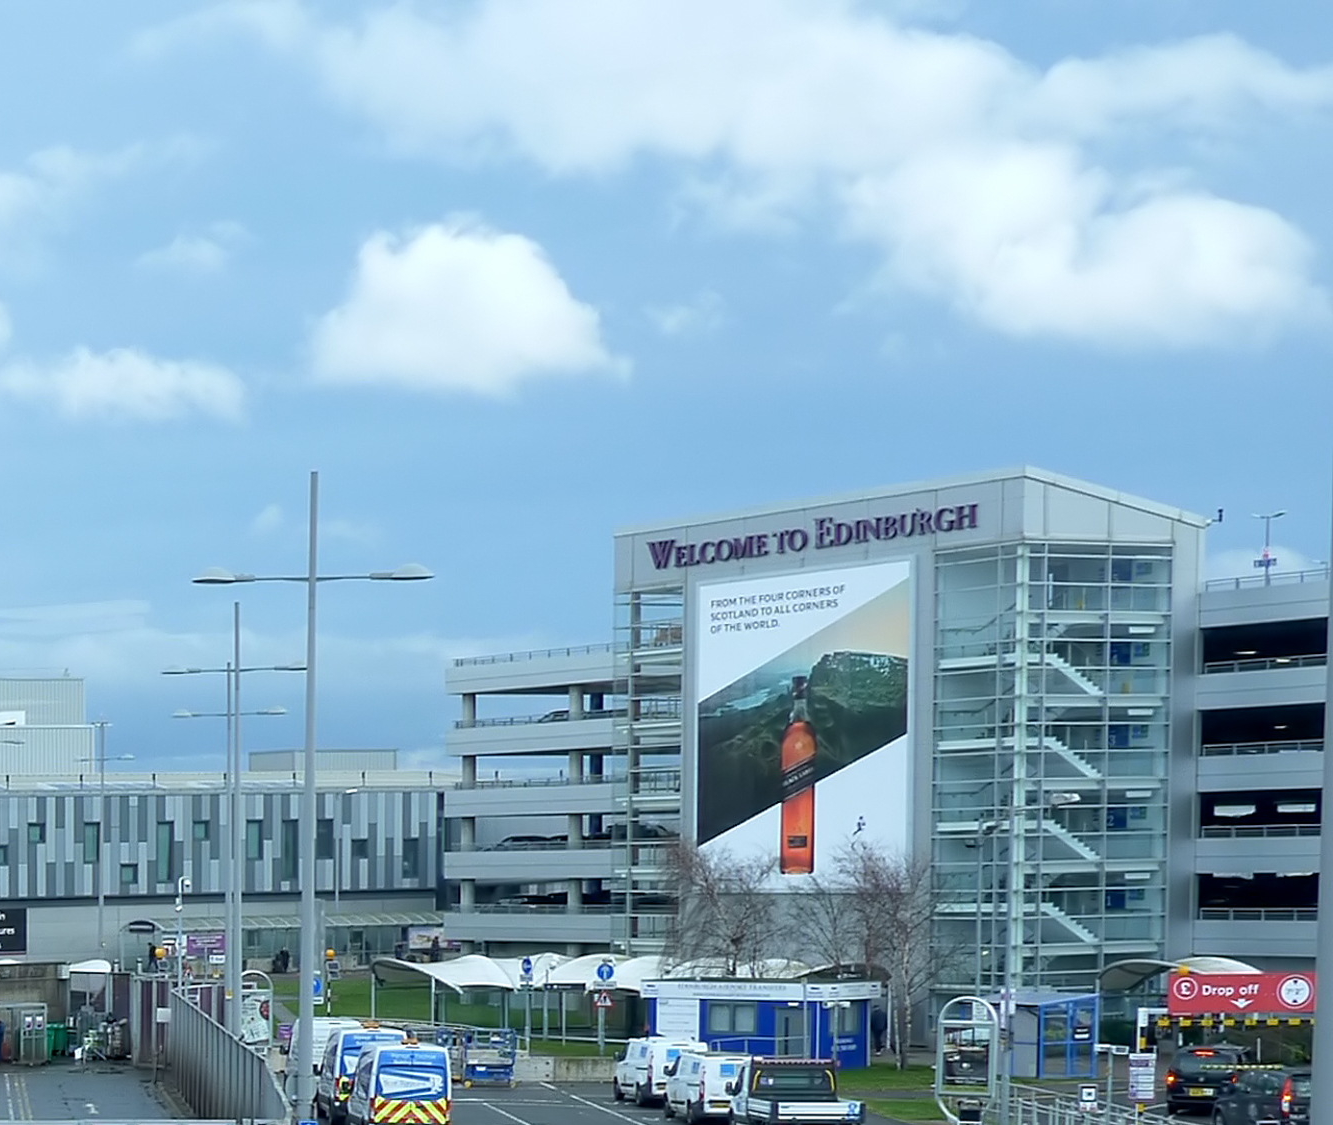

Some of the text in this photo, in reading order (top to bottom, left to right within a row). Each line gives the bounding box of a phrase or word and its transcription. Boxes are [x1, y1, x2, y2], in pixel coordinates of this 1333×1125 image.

[647, 503, 979, 570] WELCOME TO EDINBURGH
[711, 584, 846, 609] FROM THE FOUR CORNERS OF
[710, 599, 839, 622] SCOTLAND TO ALL CORNERS
[710, 625, 722, 635] OF
[724, 623, 742, 632] THE
[1201, 985, 1234, 997] Drop
[1239, 984, 1259, 995] off
